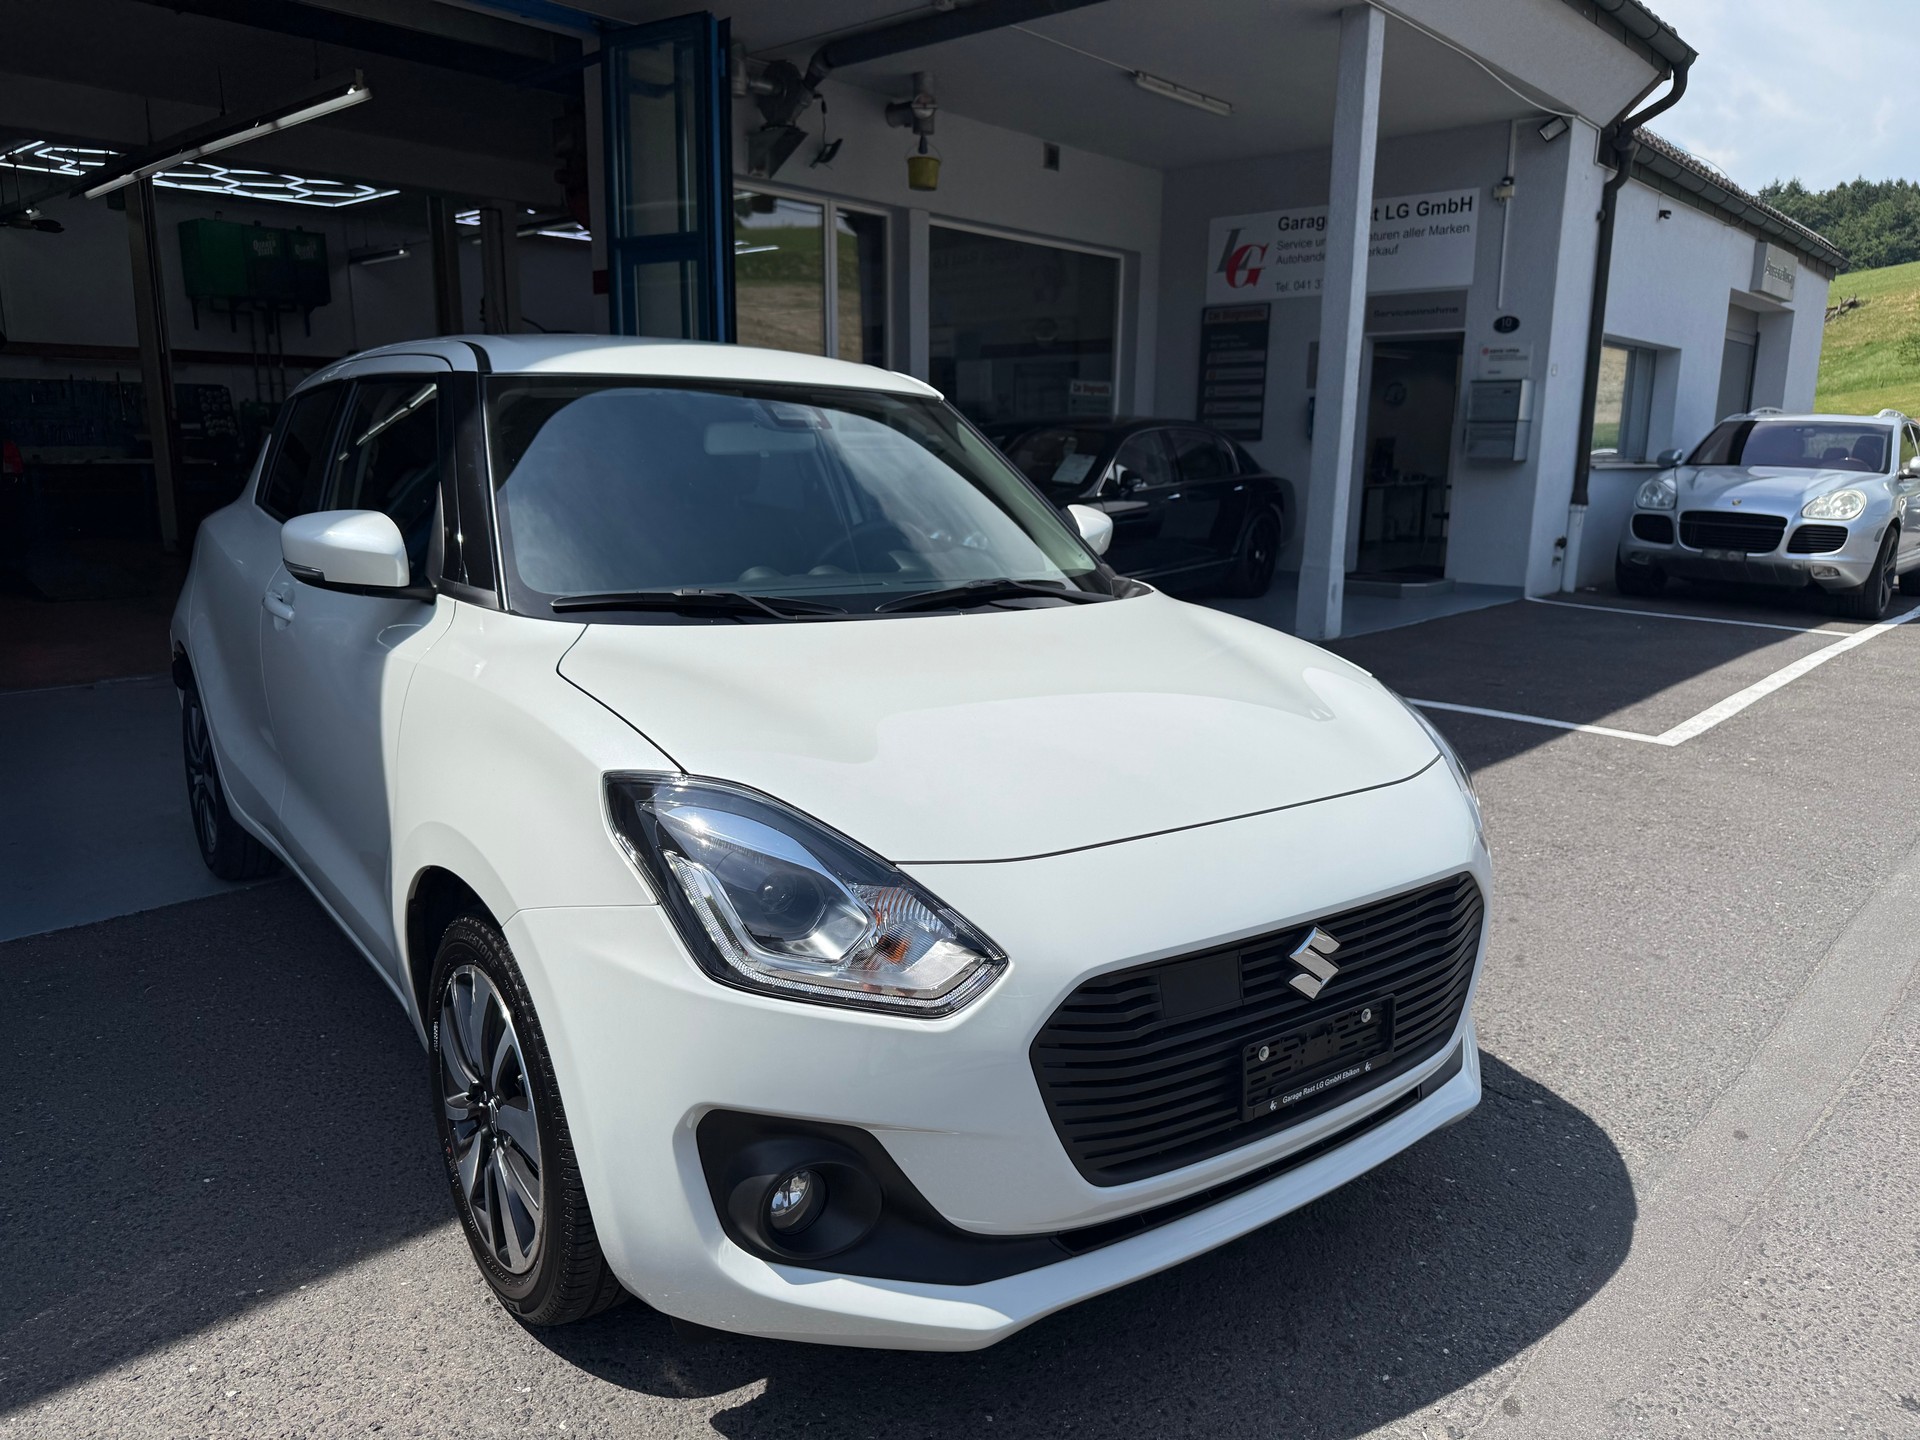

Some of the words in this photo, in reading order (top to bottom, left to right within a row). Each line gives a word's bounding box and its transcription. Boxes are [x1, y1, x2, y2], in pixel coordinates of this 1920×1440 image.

[1278, 216, 1328, 231] Garag
[1385, 203, 1409, 220] LG
[1416, 196, 1473, 217] GmbH
[1277, 239, 1312, 251] Service
[1403, 227, 1425, 239] aller
[1429, 224, 1470, 236] Marken
[1276, 251, 1325, 265] Autohande
[1368, 244, 1399, 257] erkauf
[1294, 280, 1311, 291] 041
[1501, 317, 1513, 328] 10
[1282, 1091, 1302, 1104] Garage
[1303, 1085, 1315, 1096] Rast
[1316, 1081, 1324, 1090] LG
[1325, 1074, 1342, 1087] GmbH
[1342, 1067, 1360, 1079] Ebikon
